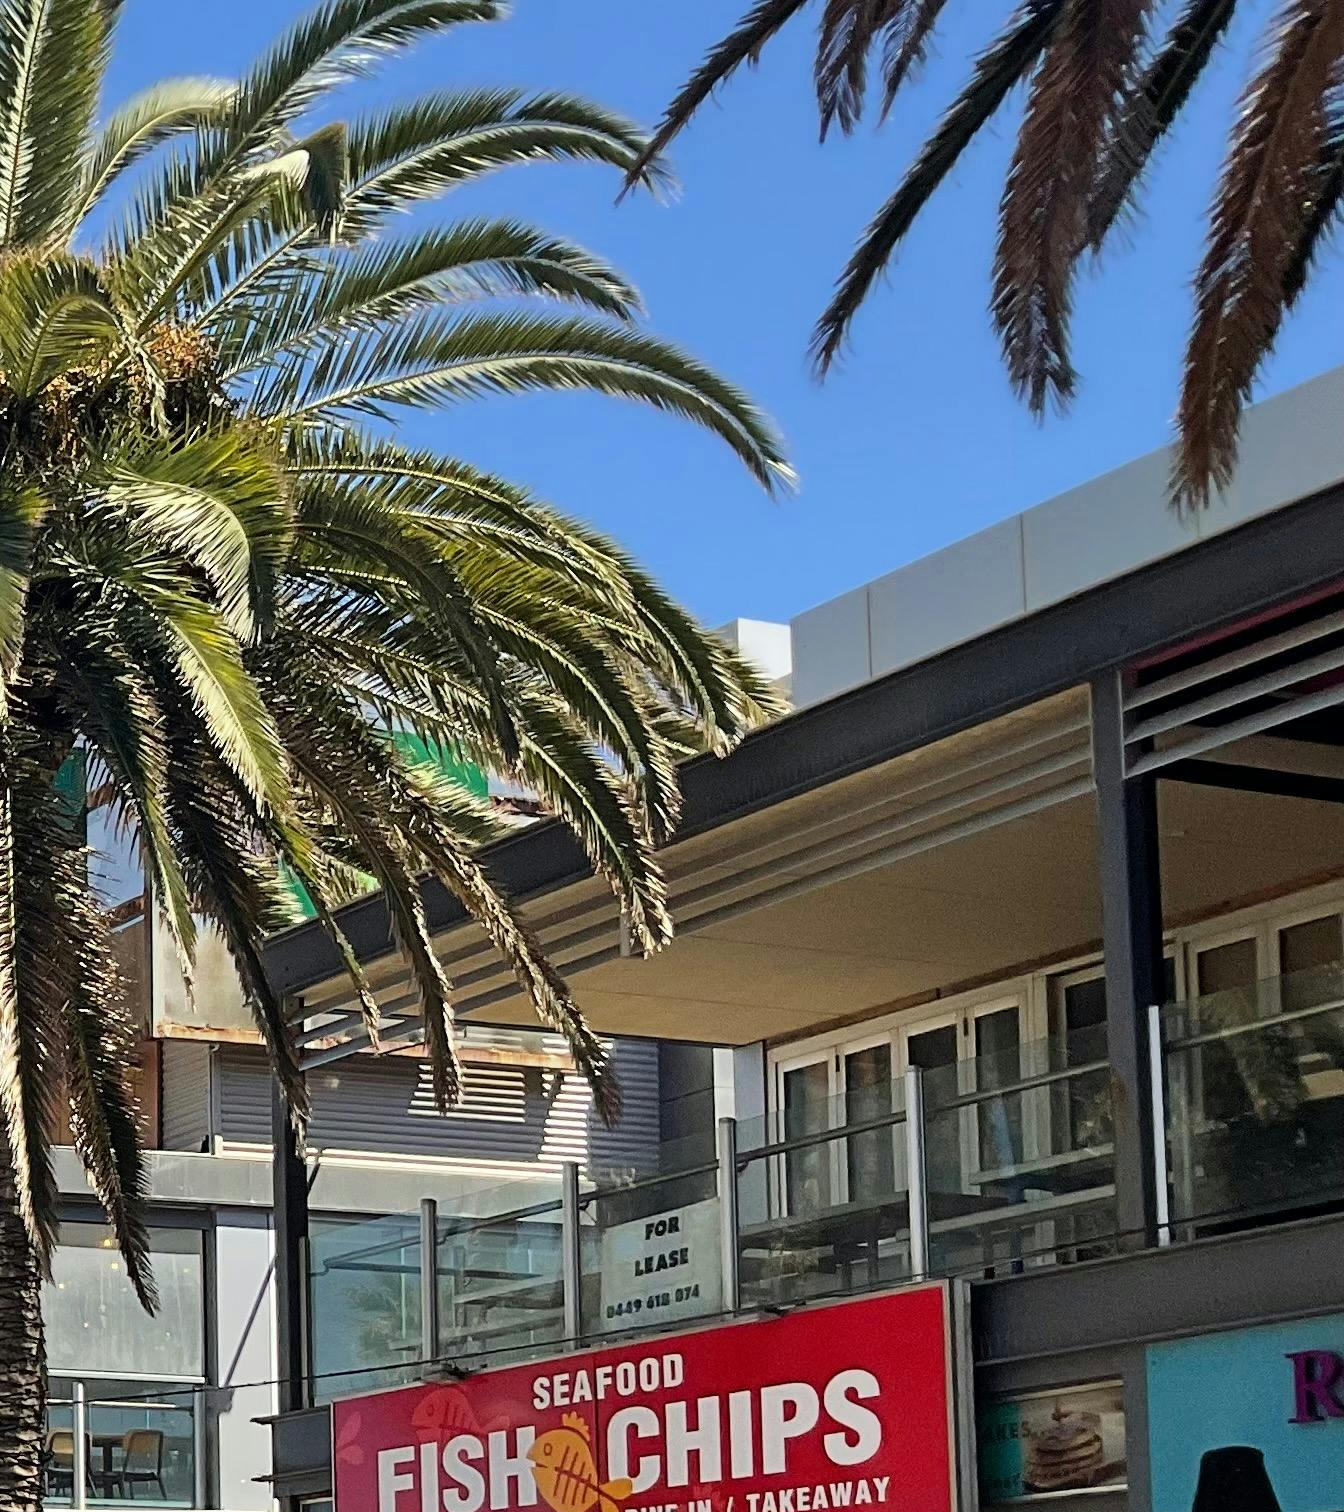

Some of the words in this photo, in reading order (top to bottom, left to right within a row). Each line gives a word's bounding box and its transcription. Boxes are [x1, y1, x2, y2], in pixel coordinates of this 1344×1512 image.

[645, 1216, 680, 1240] FOR
[635, 1247, 689, 1276] LEASE
[533, 1353, 684, 1410] SEAFOOD
[607, 1369, 882, 1495] CHIPS
